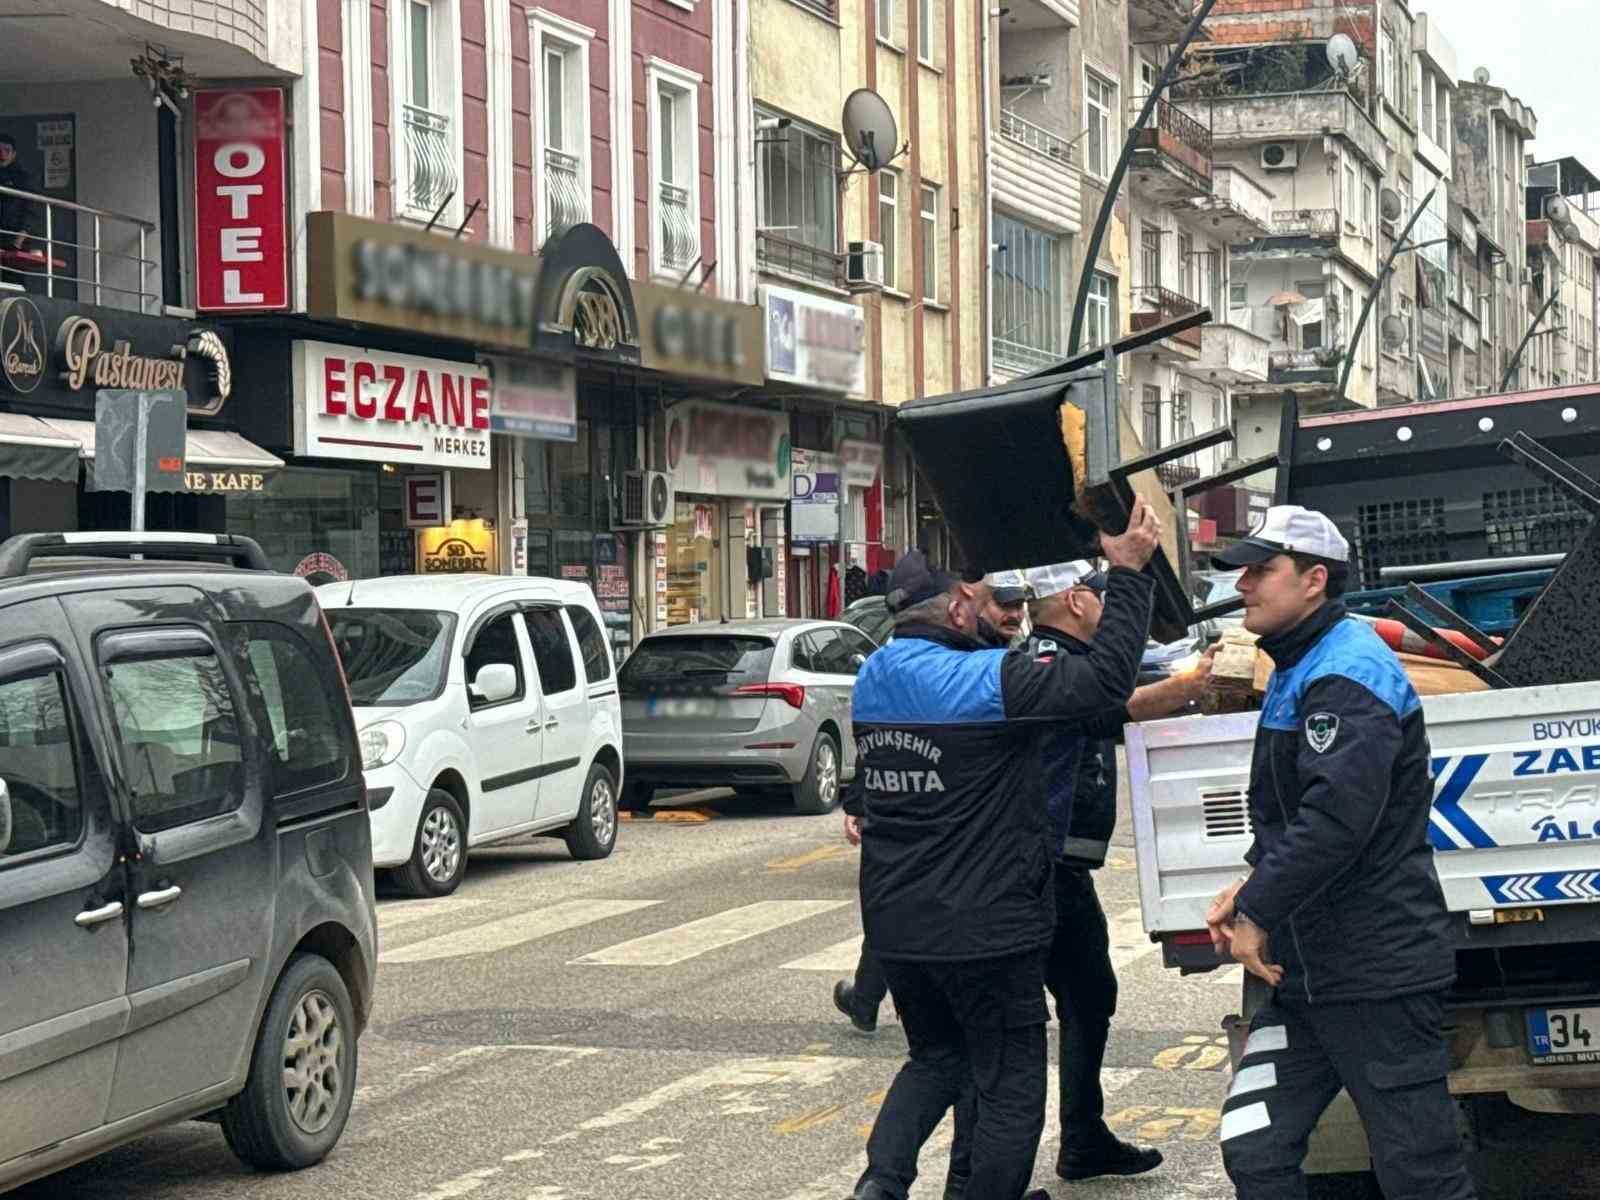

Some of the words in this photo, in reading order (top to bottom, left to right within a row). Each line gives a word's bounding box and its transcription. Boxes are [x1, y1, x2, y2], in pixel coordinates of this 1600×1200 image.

[213, 143, 265, 303] OTEL
[61, 316, 186, 391] Pastanesi
[324, 357, 490, 430] ECZANE
[433, 437, 487, 457] MERKEZ
[210, 472, 264, 491] KAFE
[408, 480, 438, 521] E
[864, 767, 945, 793] ZABITA
[1537, 819, 1600, 842] AL
[1533, 1034, 1550, 1046] TR
[1550, 1013, 1591, 1048] 34
